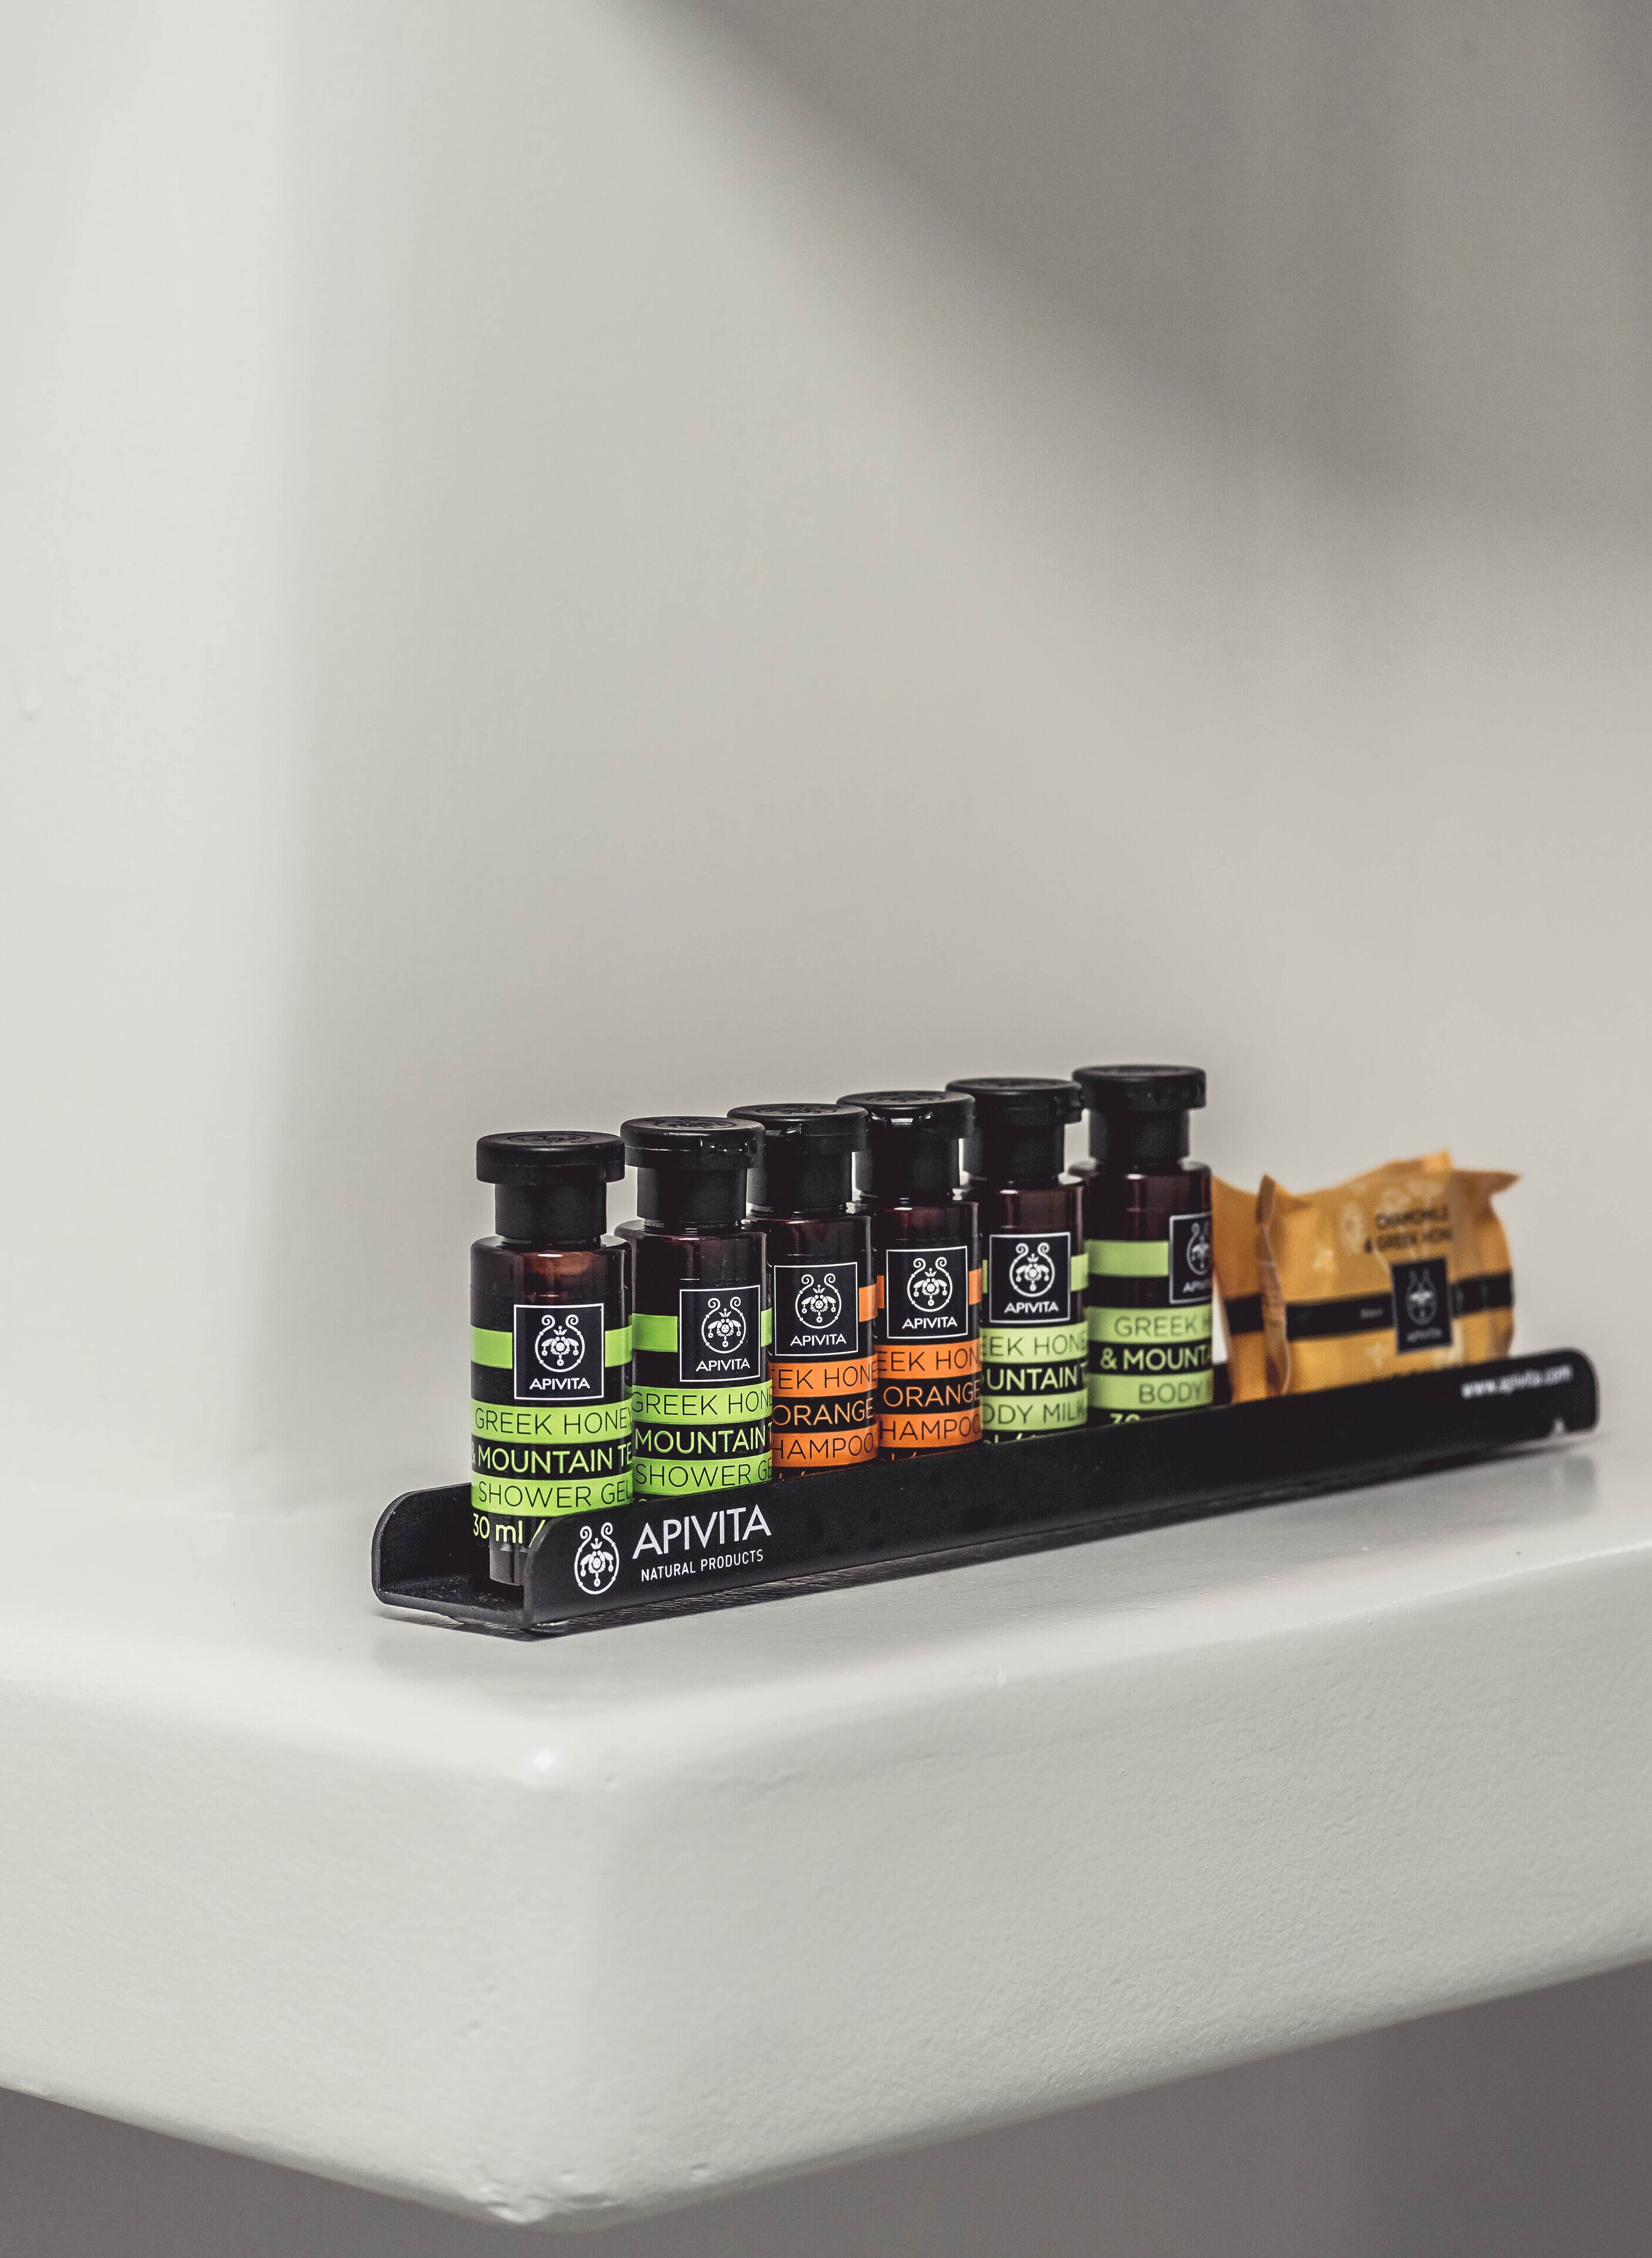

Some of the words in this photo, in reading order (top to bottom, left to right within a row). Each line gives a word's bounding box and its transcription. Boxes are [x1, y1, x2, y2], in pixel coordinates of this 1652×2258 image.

[1004, 1301, 1059, 1314] APIVITA
[902, 1316, 958, 1330] APIVITA
[1115, 1315, 1197, 1337] GREEK
[790, 1334, 847, 1346] APIVITA
[696, 1358, 750, 1372] APIVITA
[1100, 1347, 1117, 1370] &
[529, 1378, 590, 1390] APIVITA
[771, 1368, 814, 1389] EK
[982, 1365, 1078, 1391] UNTAIN
[632, 1391, 718, 1415] GREEK
[884, 1379, 980, 1408] ORANGE
[1139, 1381, 1203, 1404] BODY
[475, 1407, 552, 1435] GREEK
[772, 1397, 874, 1426] ORANGE
[635, 1425, 765, 1454] MOUNTAIN
[478, 1444, 613, 1474] MOUNTAIN
[636, 1463, 751, 1488] SHOWER
[479, 1481, 592, 1508] SHOWER
[601, 1479, 632, 1505] GEL
[473, 1512, 490, 1539] 30
[495, 1519, 523, 1544] ml
[632, 1504, 772, 1559] APIVITA
[641, 1561, 696, 1582] NATURAL
[701, 1548, 764, 1572] PRODUCTS
